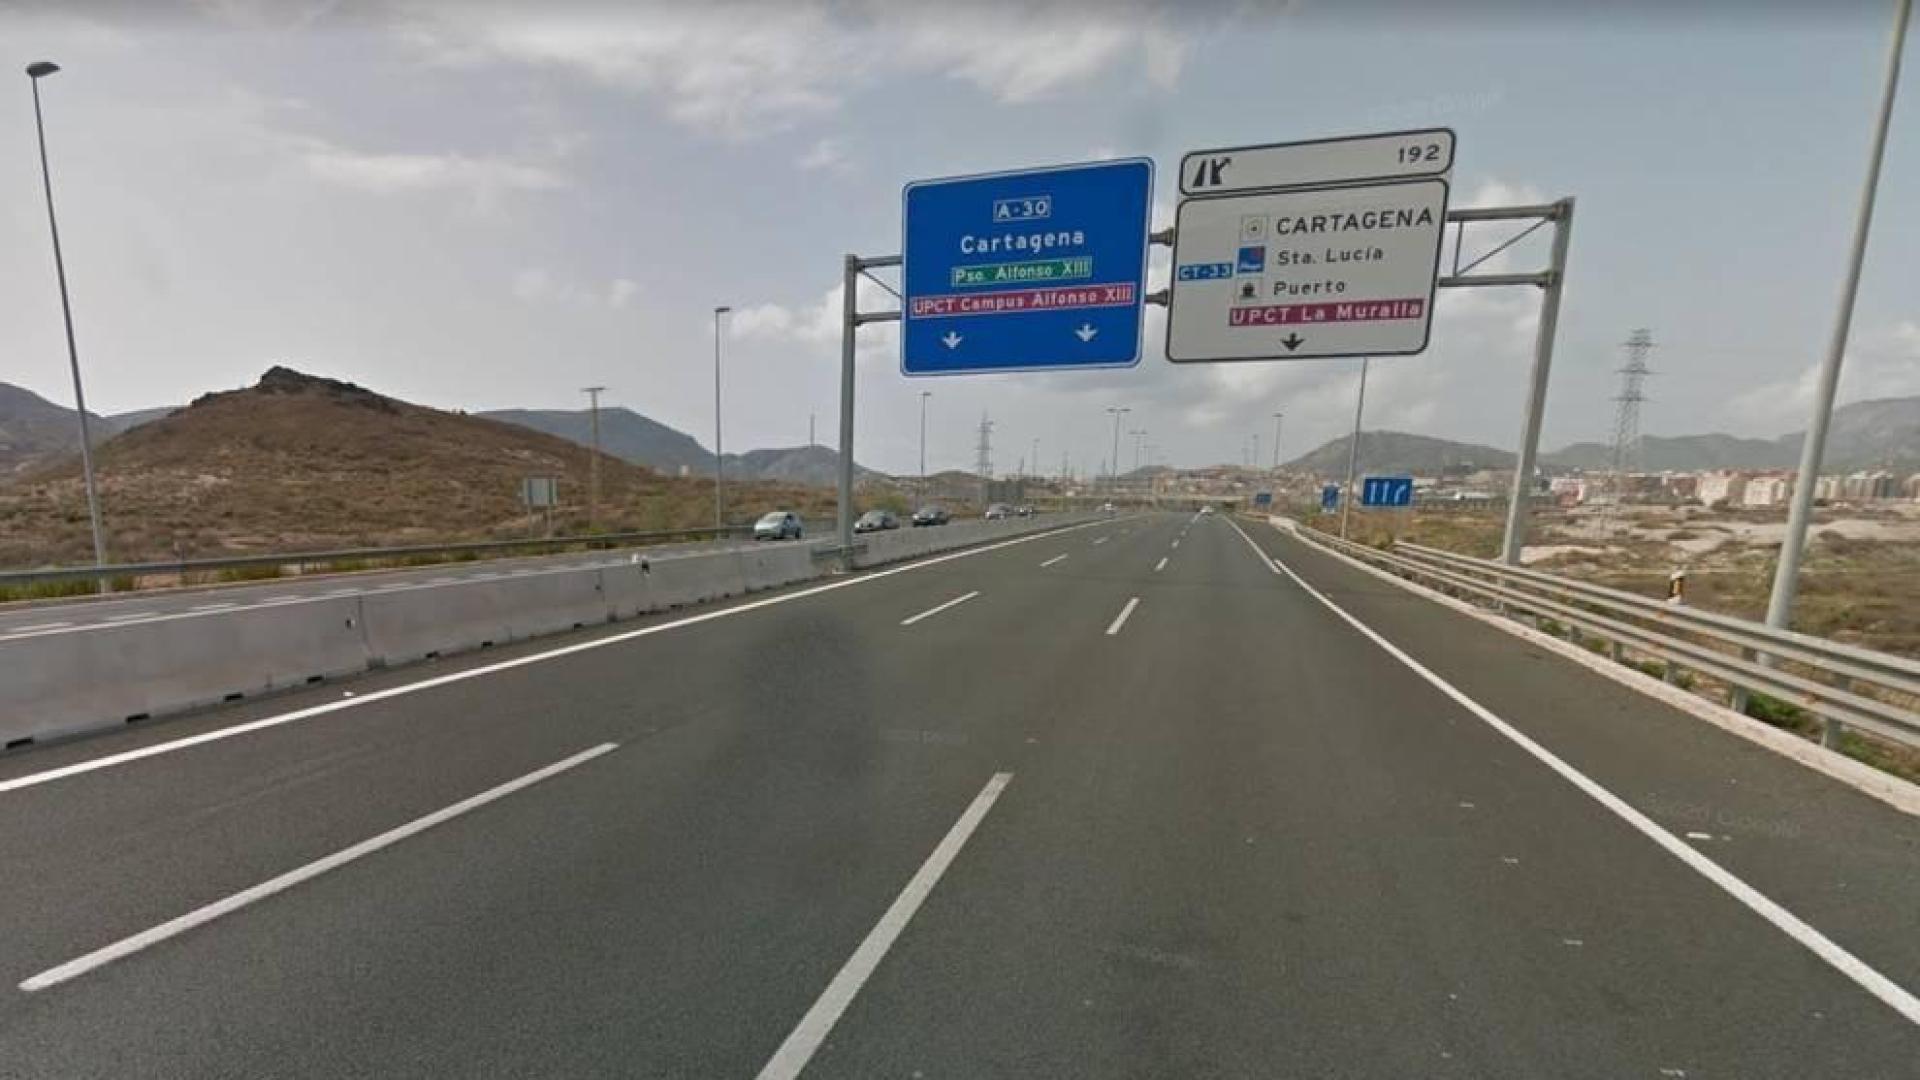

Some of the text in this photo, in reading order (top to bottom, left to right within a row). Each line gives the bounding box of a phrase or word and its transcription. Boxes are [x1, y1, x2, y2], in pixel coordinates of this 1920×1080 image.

[1399, 145, 1440, 163] 192
[998, 201, 1047, 218] A-30
[1277, 207, 1433, 235] CARTAGENA
[961, 230, 1085, 254] Cartagena
[1278, 250, 1316, 266] Sta.
[995, 264, 1053, 281] Alfonso
[1062, 260, 1089, 276] XIII
[1274, 281, 1345, 296] Puerto
[914, 287, 1132, 314] UPCT Campus Alfonso XIII
[1231, 302, 1422, 324] UPCT La Muralla
